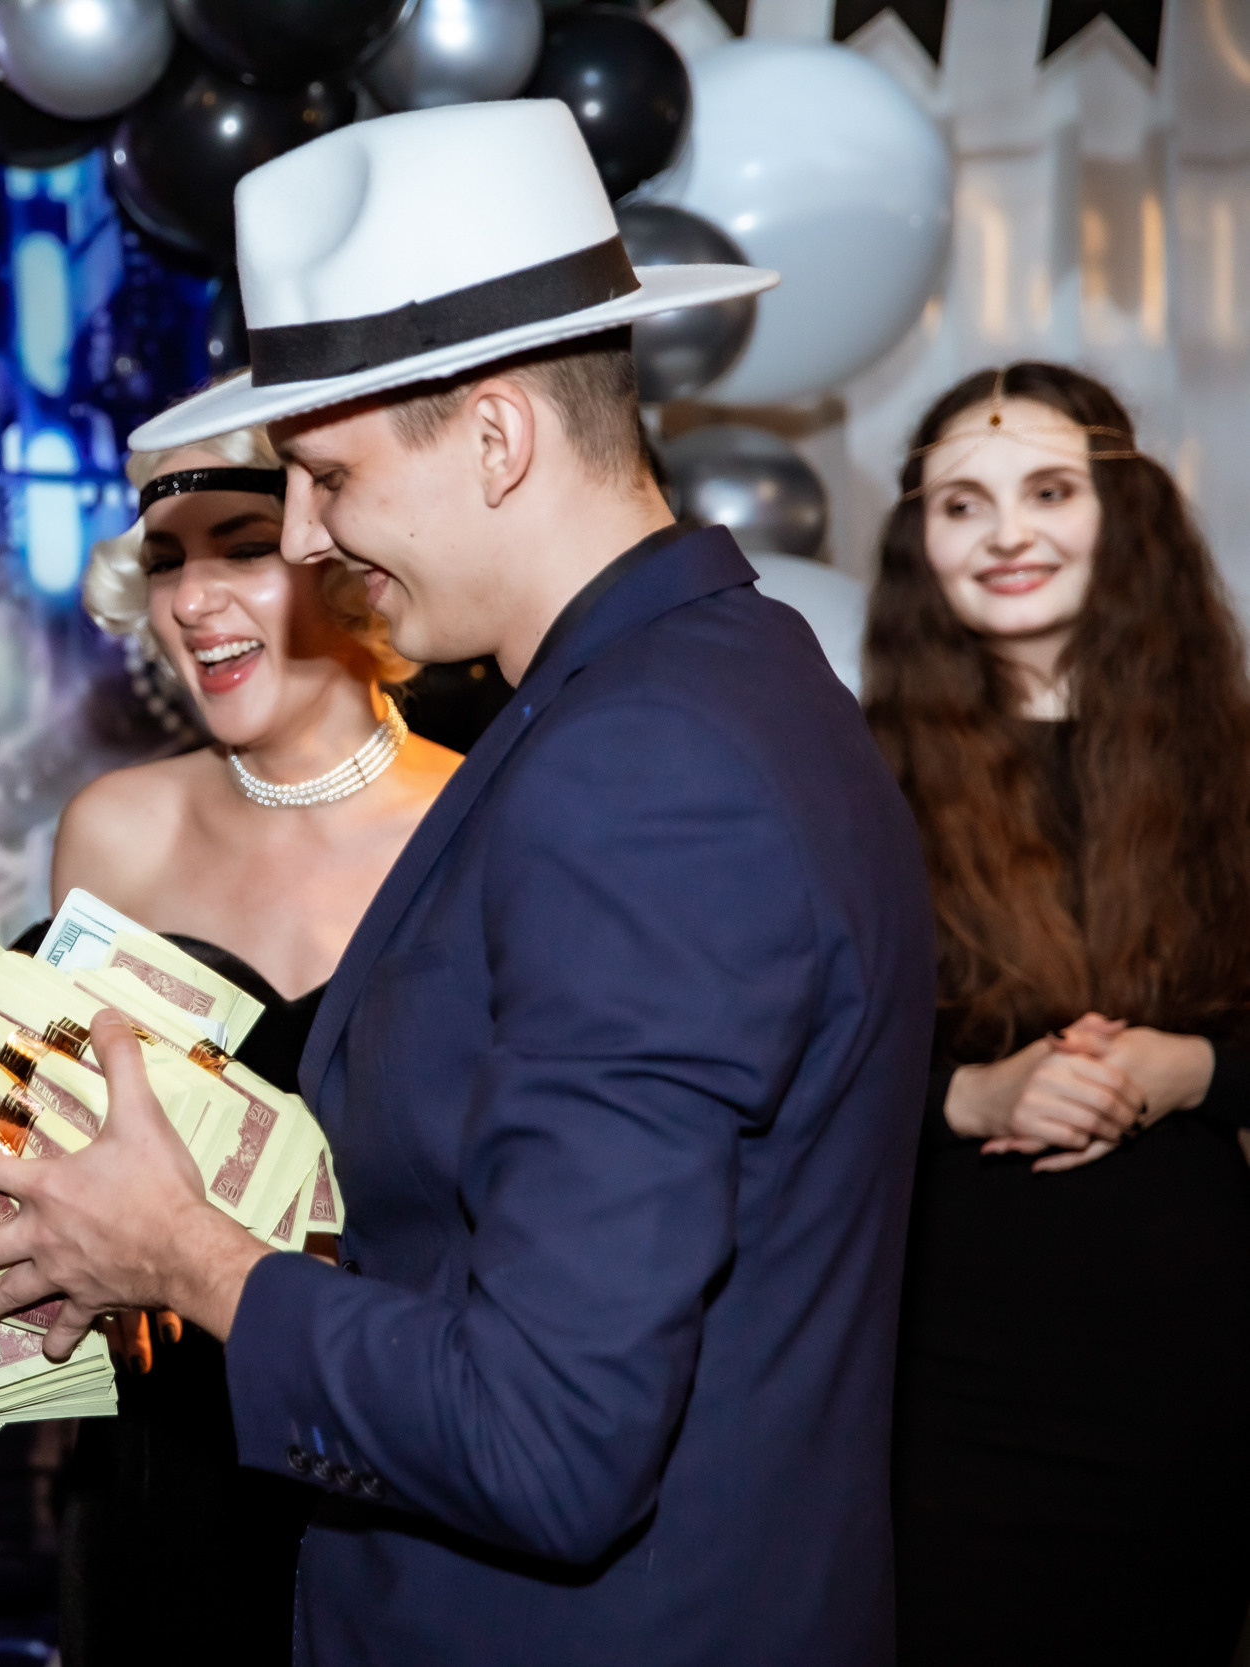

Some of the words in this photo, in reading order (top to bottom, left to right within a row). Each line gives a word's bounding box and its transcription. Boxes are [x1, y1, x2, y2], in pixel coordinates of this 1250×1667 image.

[30, 1077, 61, 1113] MERICA
[248, 1103, 271, 1127] 50
[216, 1178, 239, 1200] 50
[314, 1200, 333, 1218] 50
